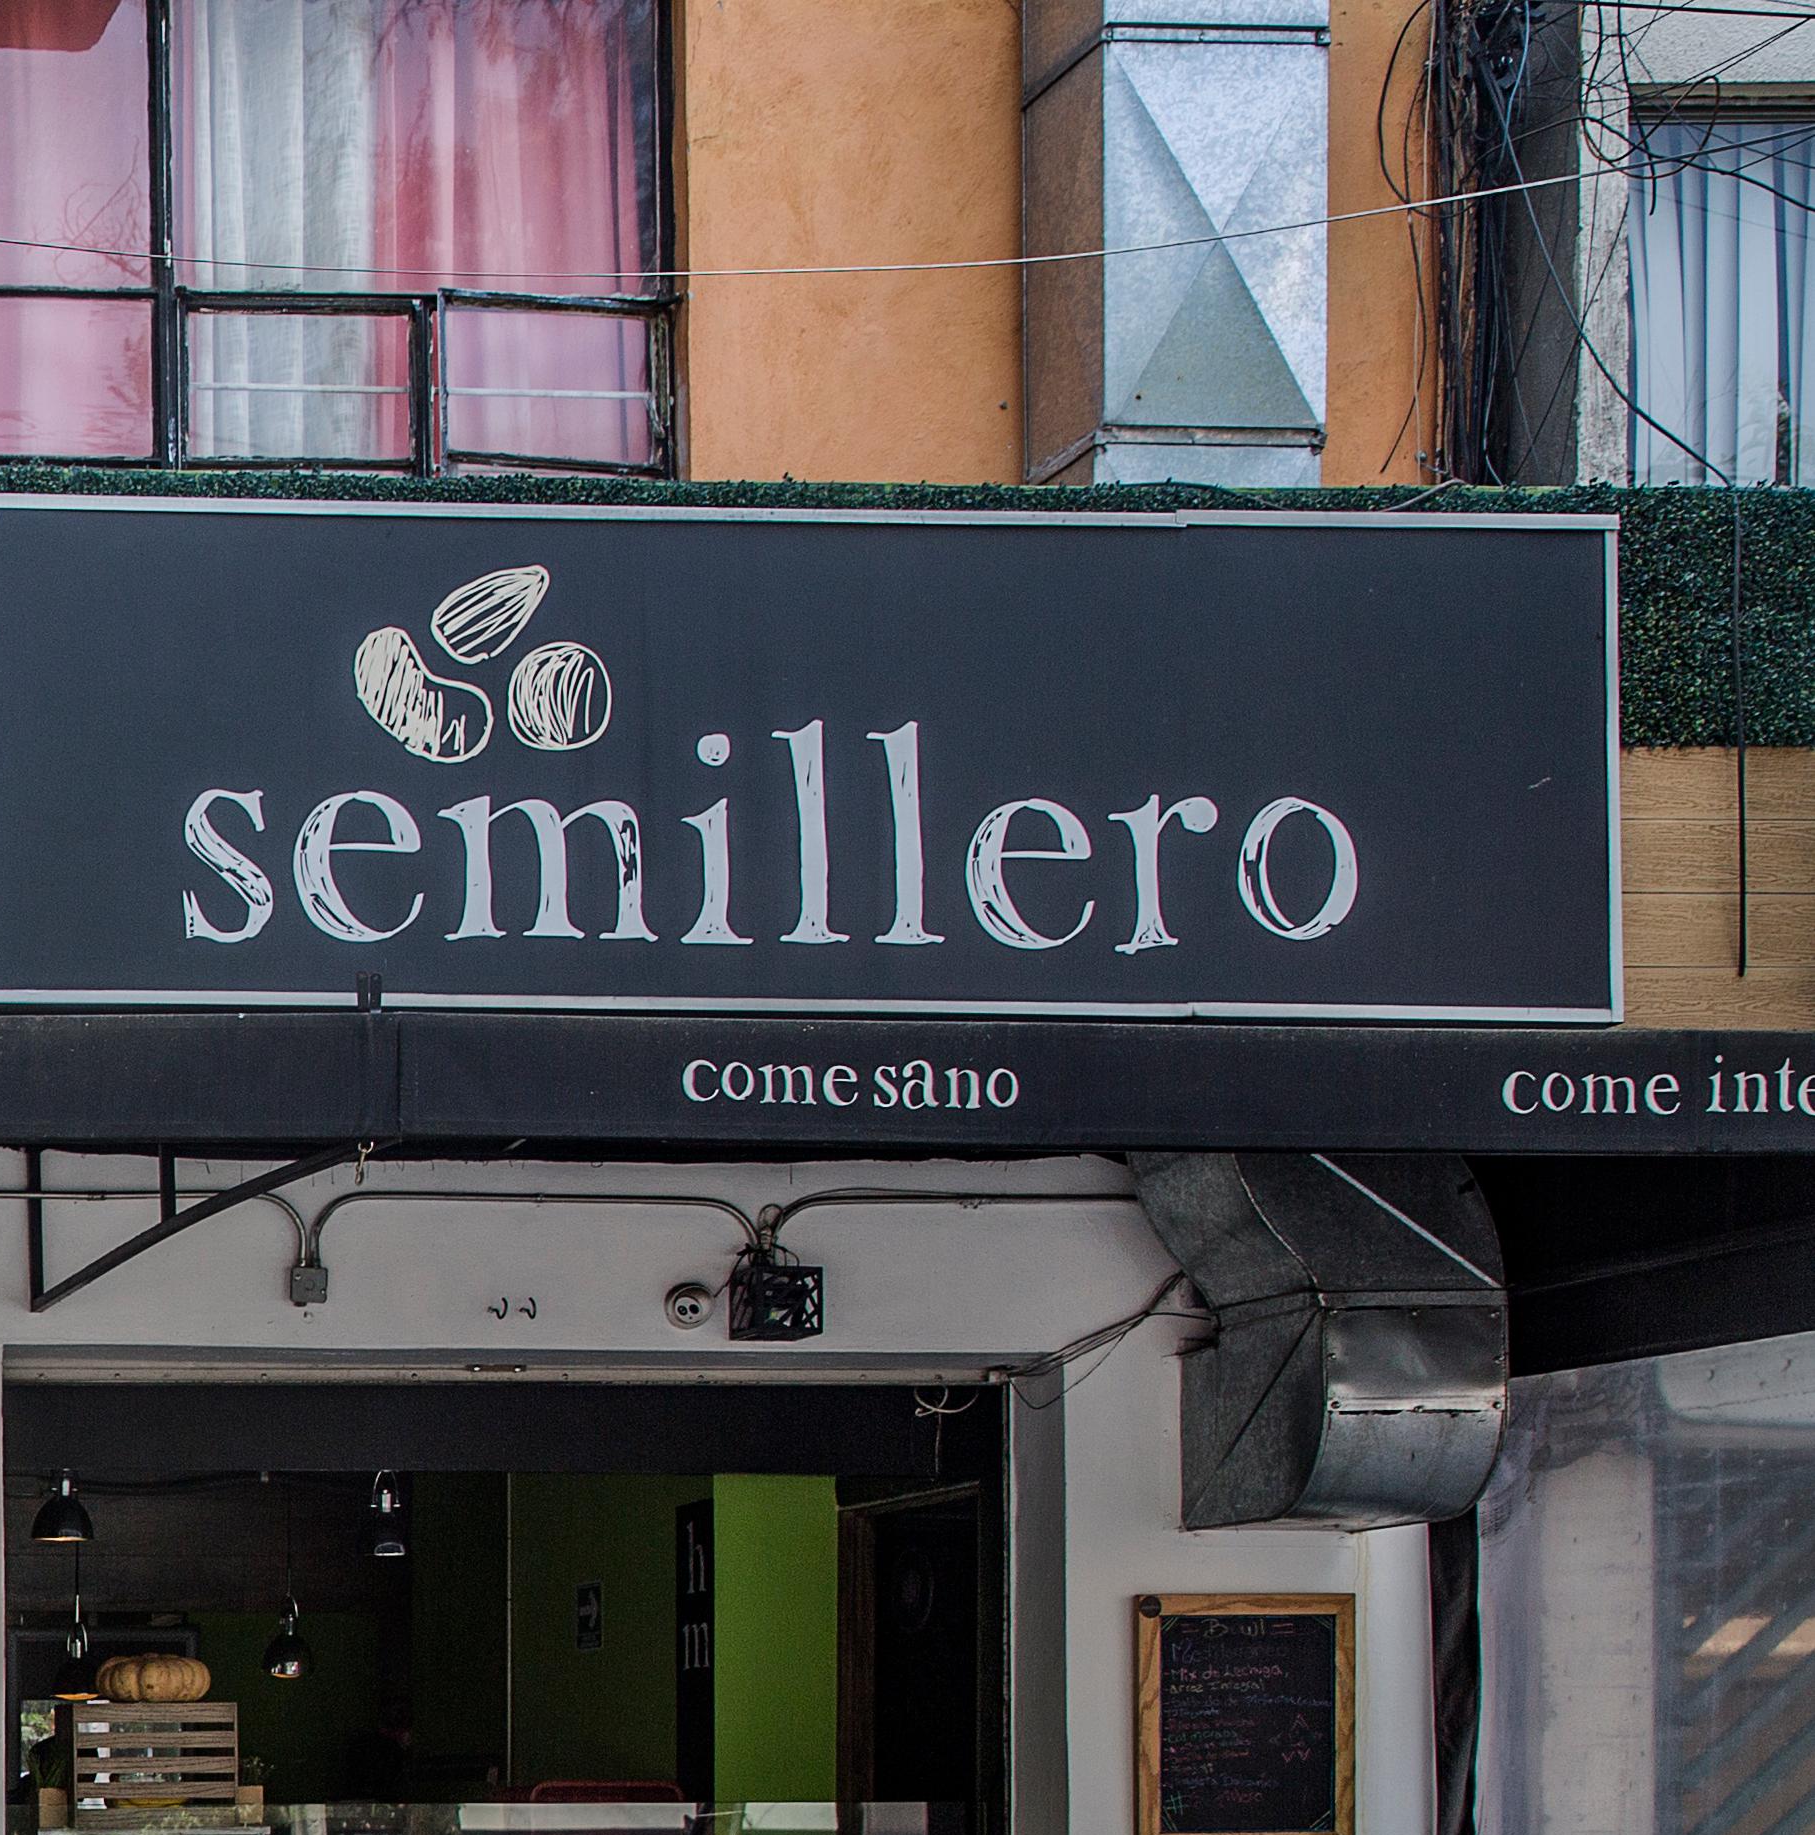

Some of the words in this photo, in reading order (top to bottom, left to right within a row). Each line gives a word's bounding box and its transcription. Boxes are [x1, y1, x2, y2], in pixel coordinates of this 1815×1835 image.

[183, 718, 1358, 954] semillero
[682, 1059, 860, 1106] come
[873, 1059, 1020, 1110] sano
[1502, 1070, 1681, 1115] come
